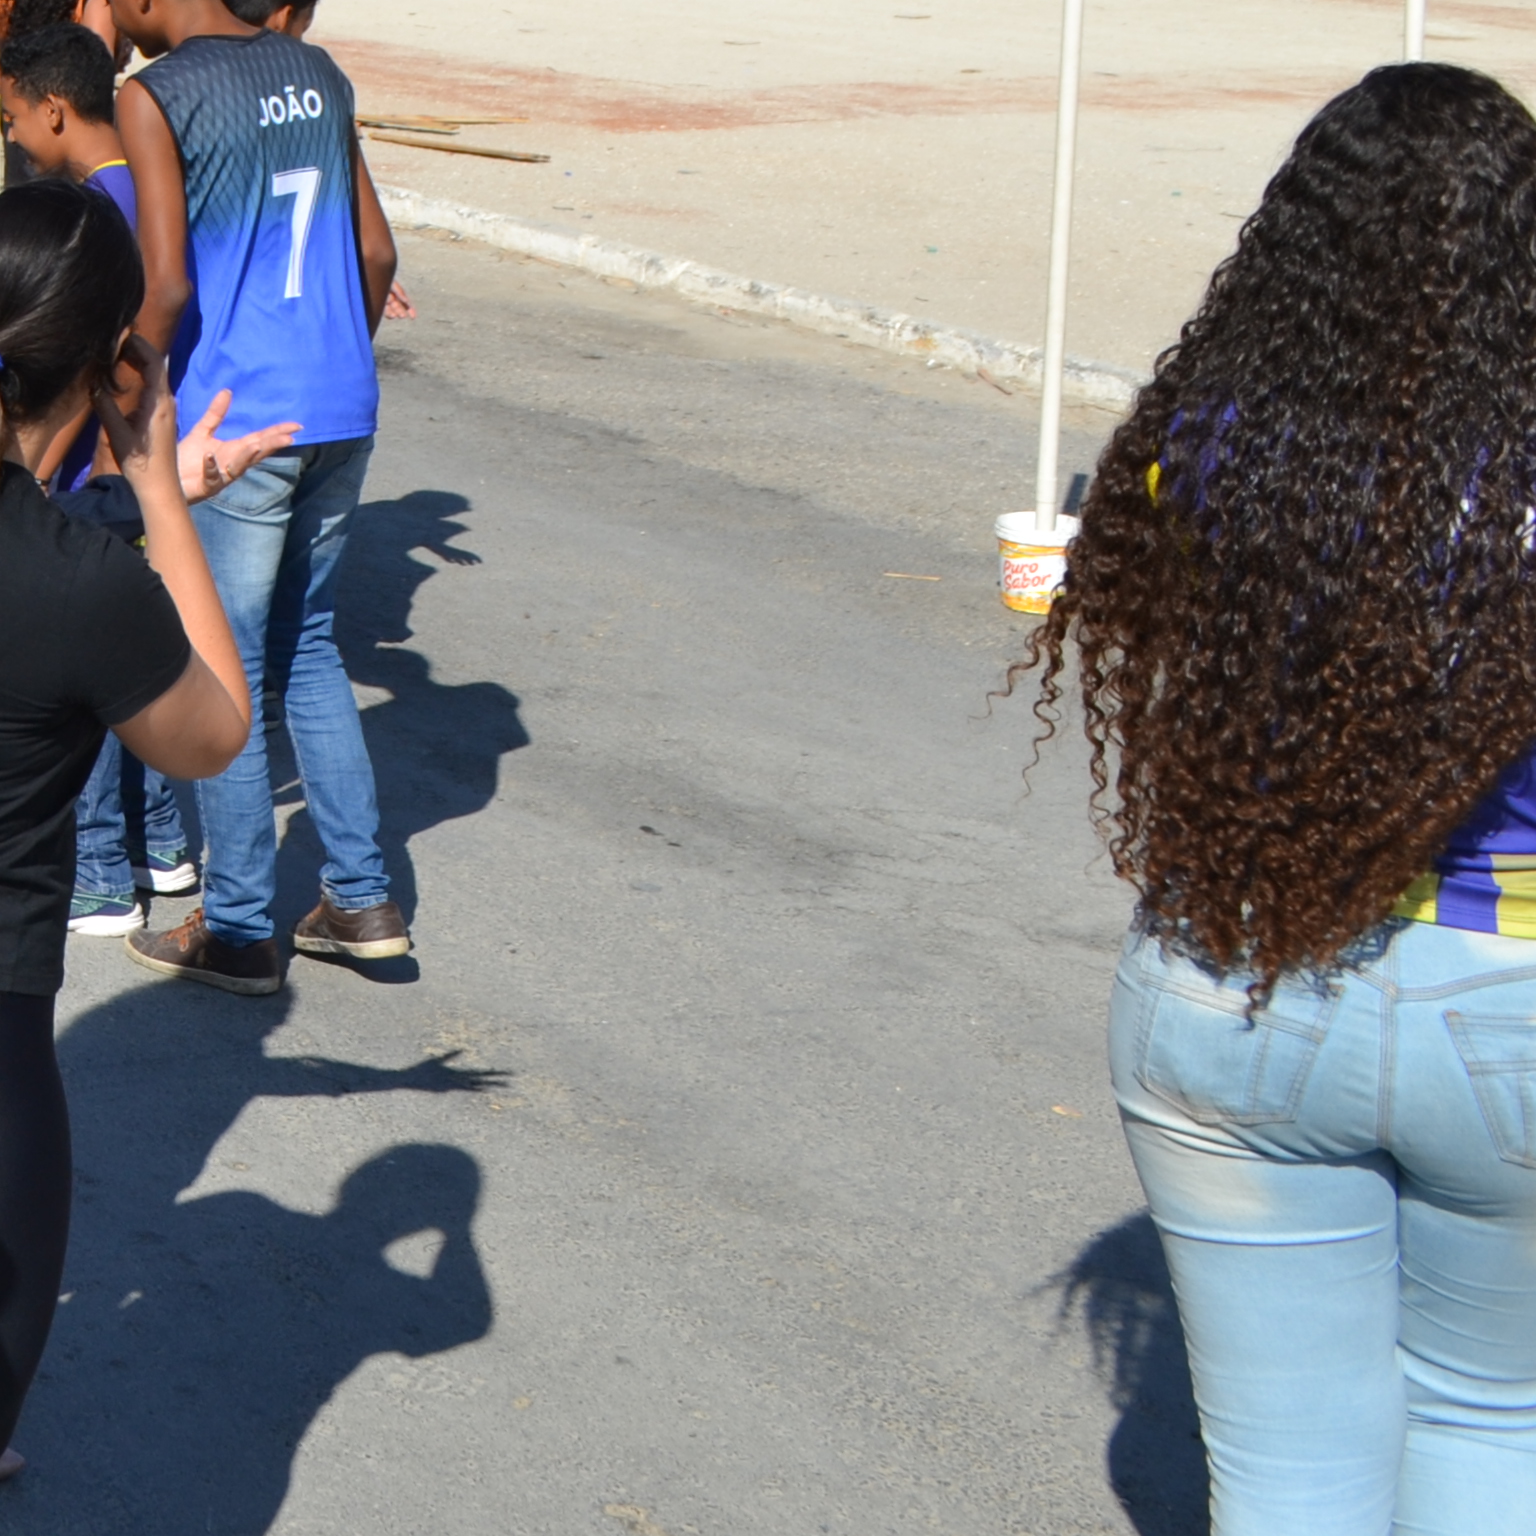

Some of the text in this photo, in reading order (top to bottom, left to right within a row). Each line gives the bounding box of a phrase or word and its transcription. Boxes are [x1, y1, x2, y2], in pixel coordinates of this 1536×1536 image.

[259, 85, 323, 127] JOÃO
[272, 167, 322, 299] 7
[1003, 559, 1039, 574] Puro
[1004, 573, 1052, 590] Sabor
